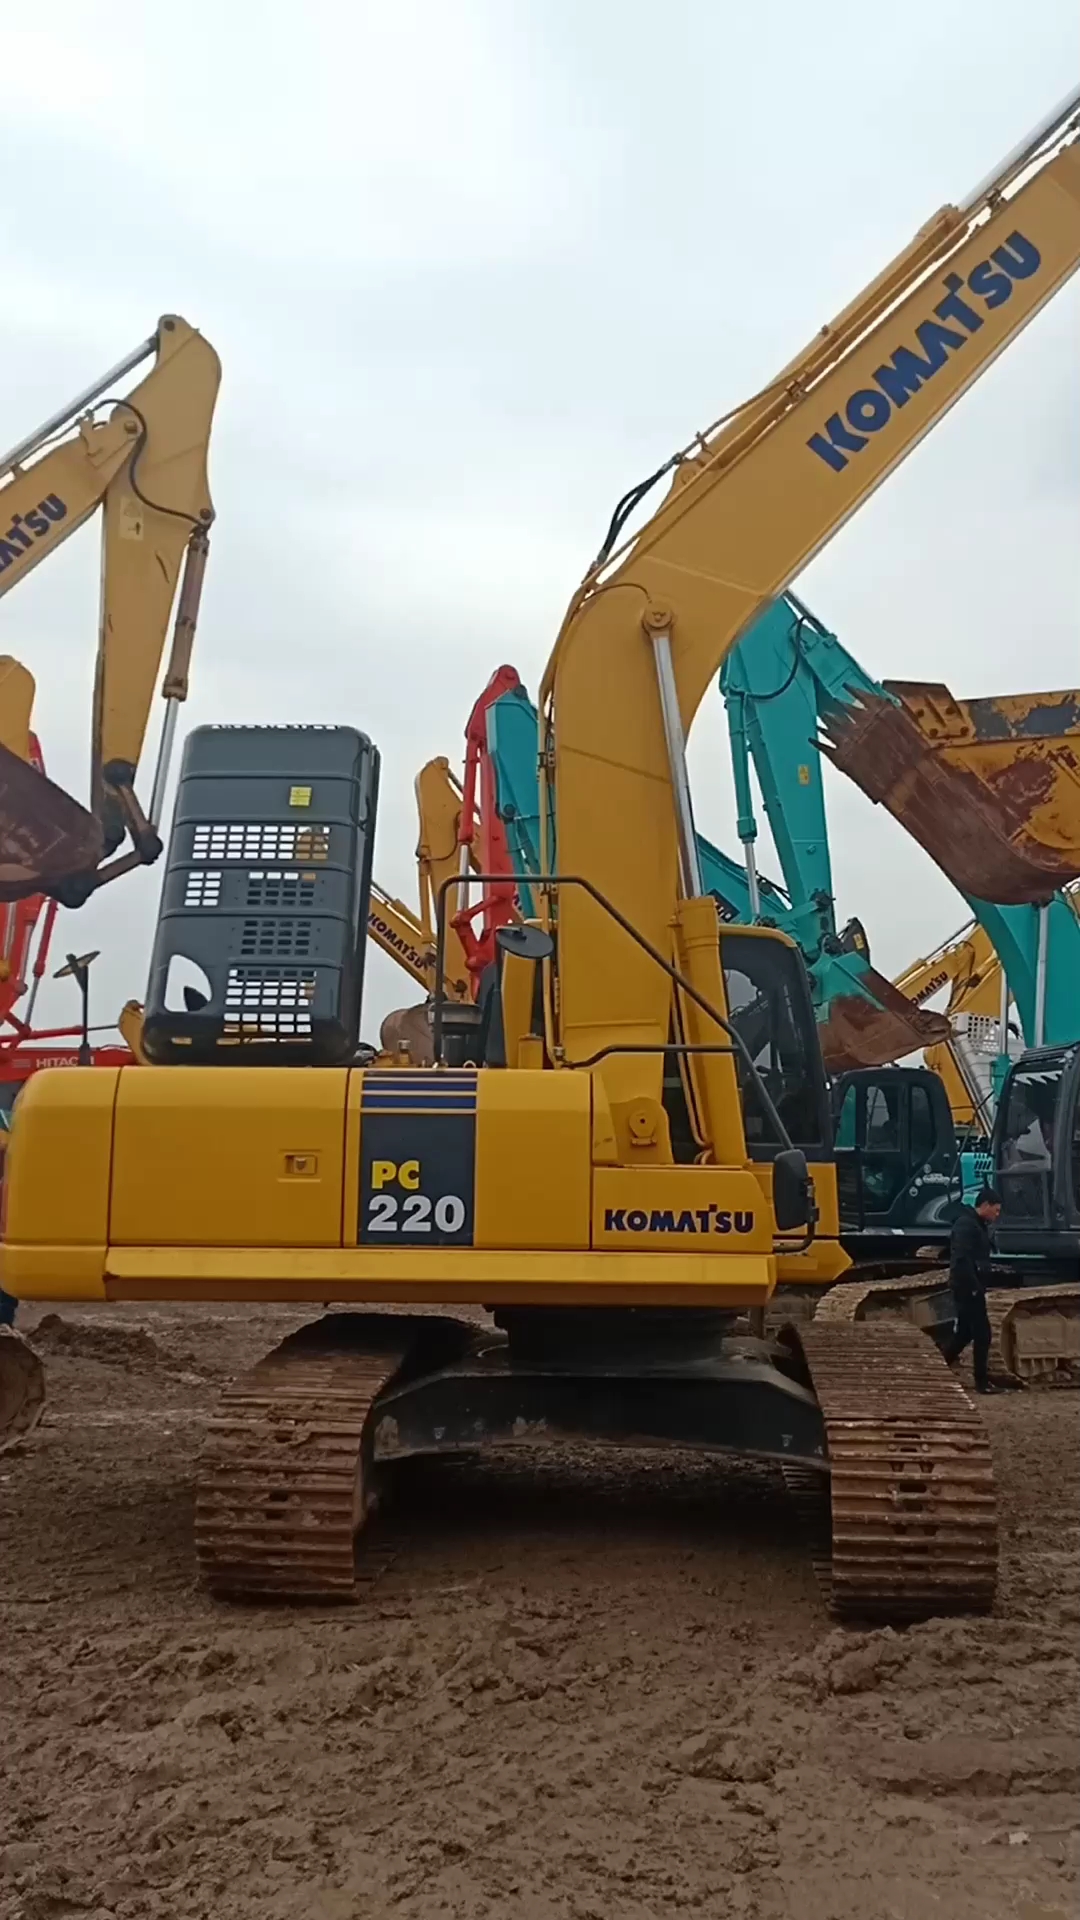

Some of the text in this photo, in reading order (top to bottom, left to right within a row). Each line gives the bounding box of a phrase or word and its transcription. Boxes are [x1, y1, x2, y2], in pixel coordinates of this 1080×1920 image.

[805, 230, 1041, 473] KOMATSU
[0, 493, 67, 574] ATSU
[36, 1056, 95, 1068] HITACI
[371, 1160, 420, 1190] PC
[367, 1194, 466, 1233] 220
[604, 1203, 754, 1233] KOMATSU
